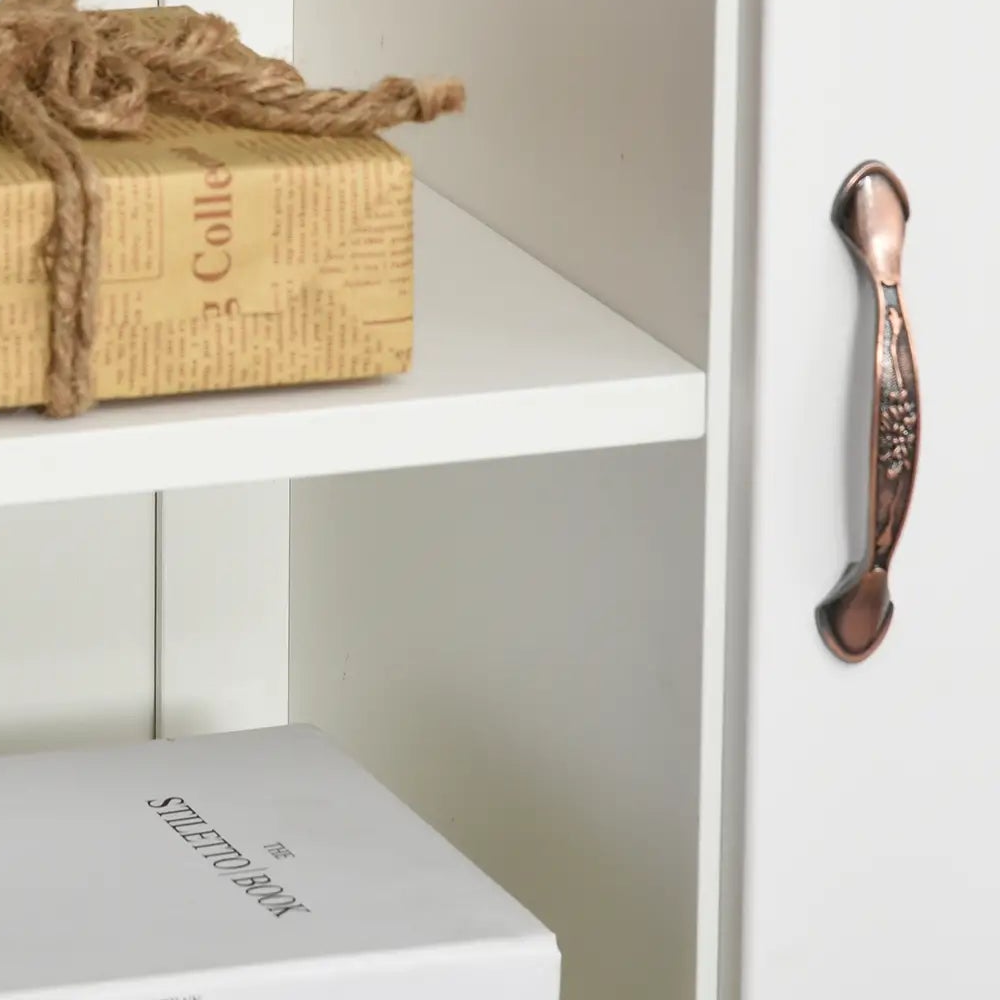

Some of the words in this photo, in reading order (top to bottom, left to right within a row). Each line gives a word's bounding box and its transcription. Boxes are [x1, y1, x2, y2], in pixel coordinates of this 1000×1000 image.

[145, 796, 251, 870] STILETTO
[231, 873, 311, 918] BOOK
[263, 841, 296, 860] THE
